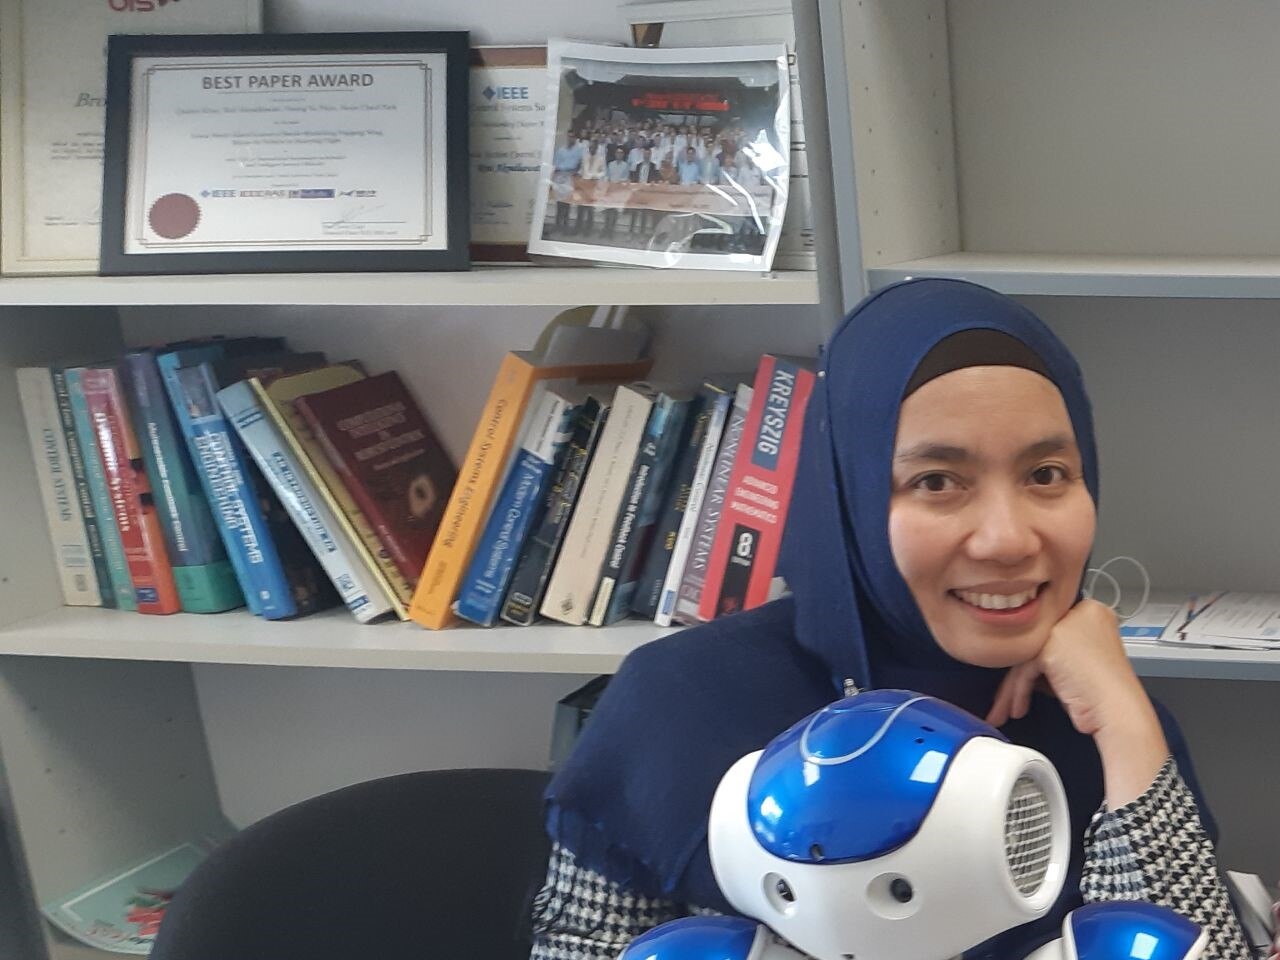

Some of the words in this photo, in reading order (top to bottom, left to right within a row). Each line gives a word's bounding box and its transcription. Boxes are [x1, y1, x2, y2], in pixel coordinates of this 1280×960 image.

[202, 76, 242, 90] BEST
[249, 75, 302, 88] PAPER
[307, 73, 374, 88] AWARD
[497, 87, 529, 99] IEEE
[486, 398, 509, 438] Control
[759, 369, 796, 456] KREYSZIG
[467, 440, 492, 484] Systems
[710, 413, 745, 504] NONLINEAR
[207, 431, 238, 496] CONTROL
[230, 498, 264, 565] SYSTEMS
[443, 484, 473, 548] Engineering
[693, 508, 721, 570] SYSTEMS
